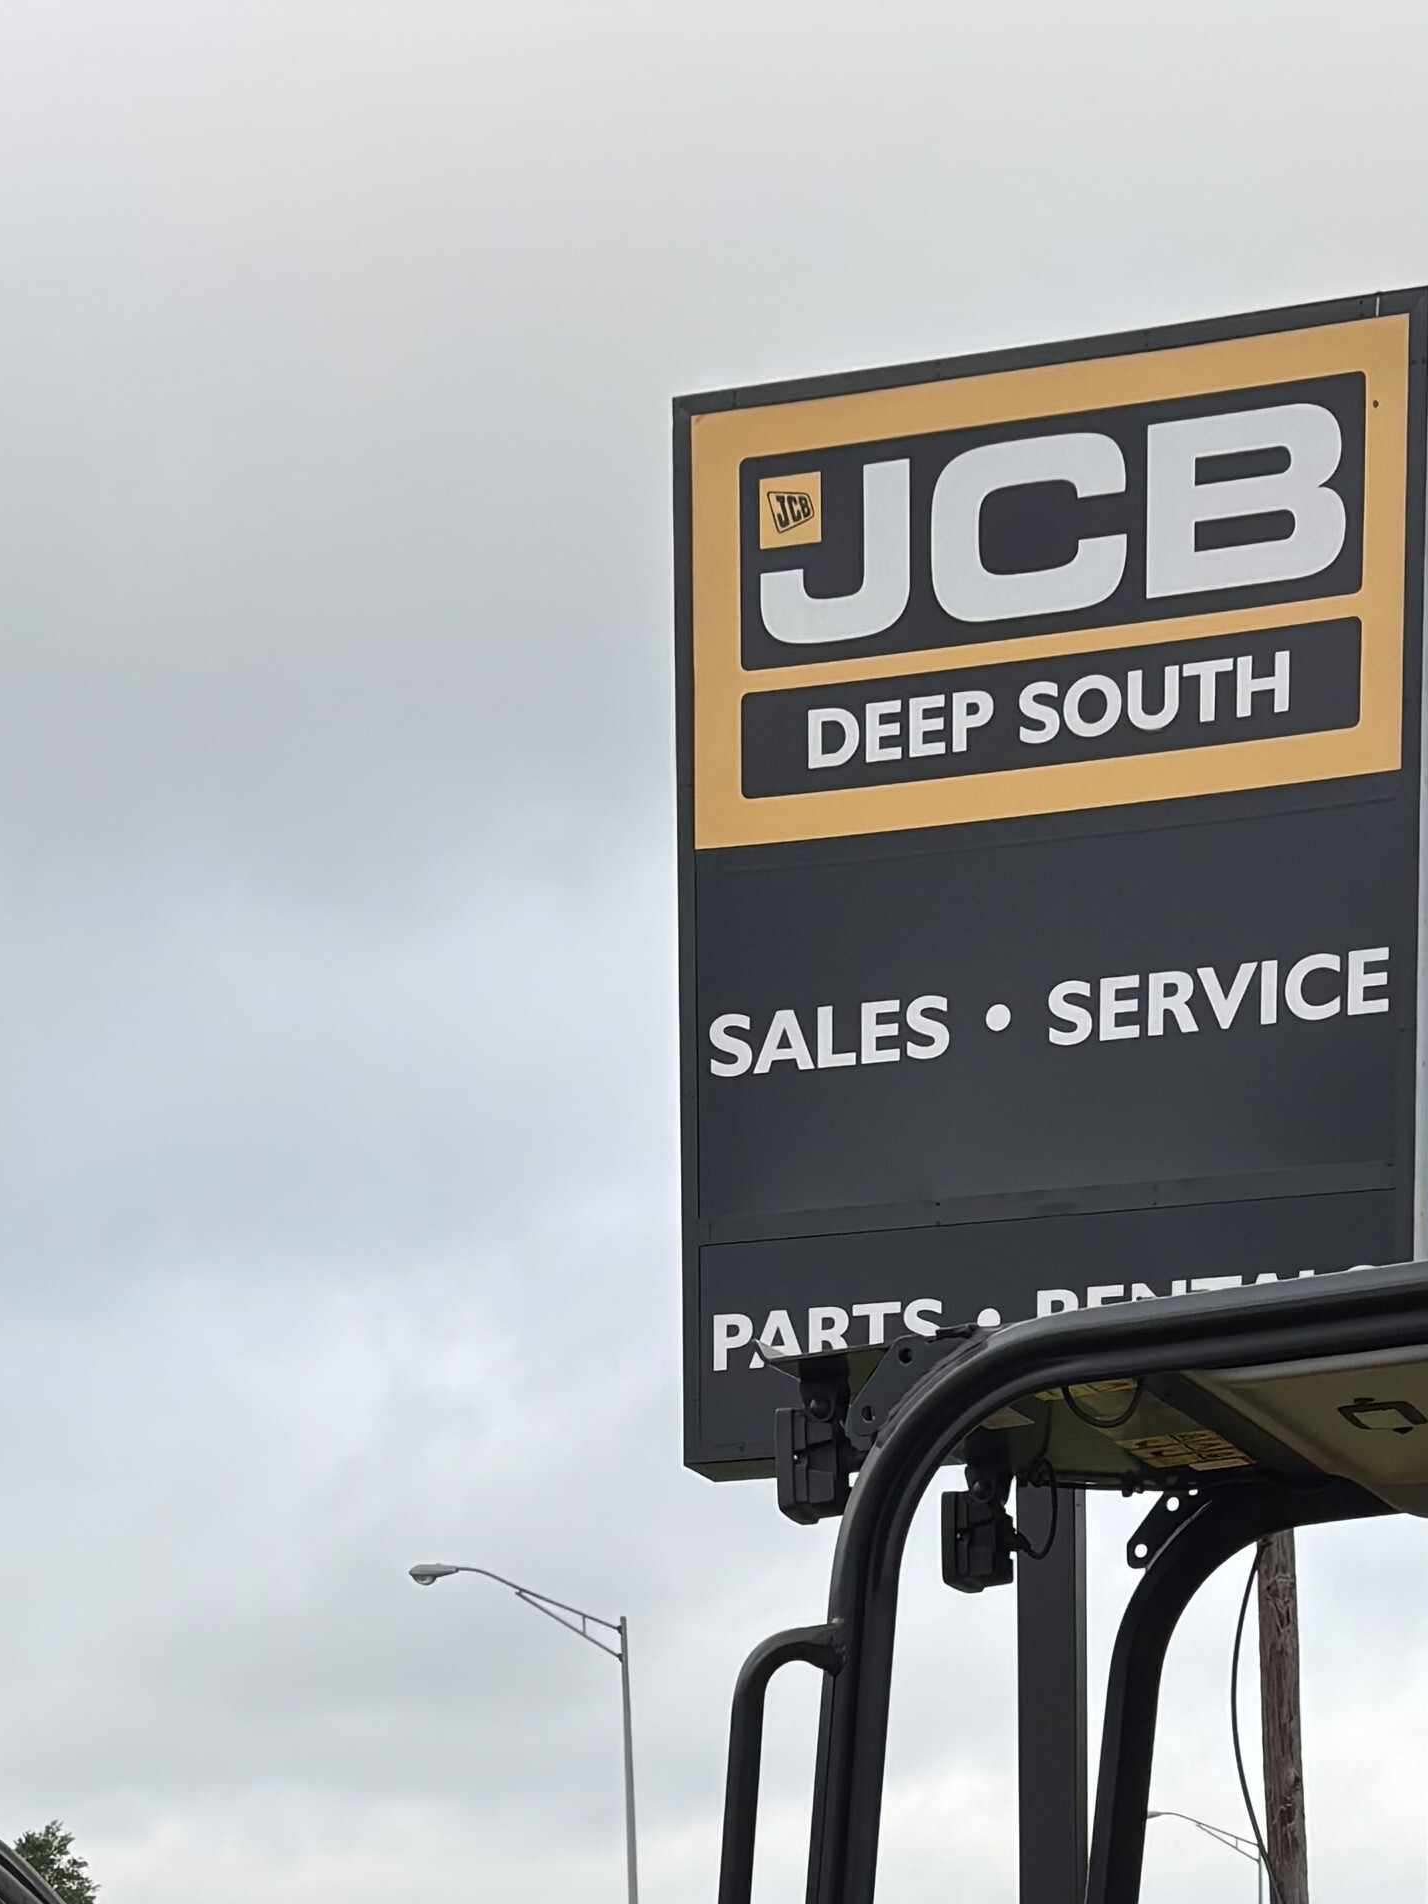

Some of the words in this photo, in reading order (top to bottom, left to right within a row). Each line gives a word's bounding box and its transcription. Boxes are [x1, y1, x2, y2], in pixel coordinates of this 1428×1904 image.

[760, 402, 1347, 645] JCB
[775, 491, 812, 529] JCB
[807, 689, 994, 769] DEEP
[1019, 650, 1291, 744] SOUTH
[709, 995, 951, 1077] SALES
[1047, 946, 1391, 1046] SERVICE
[712, 1298, 944, 1371] PARTS
